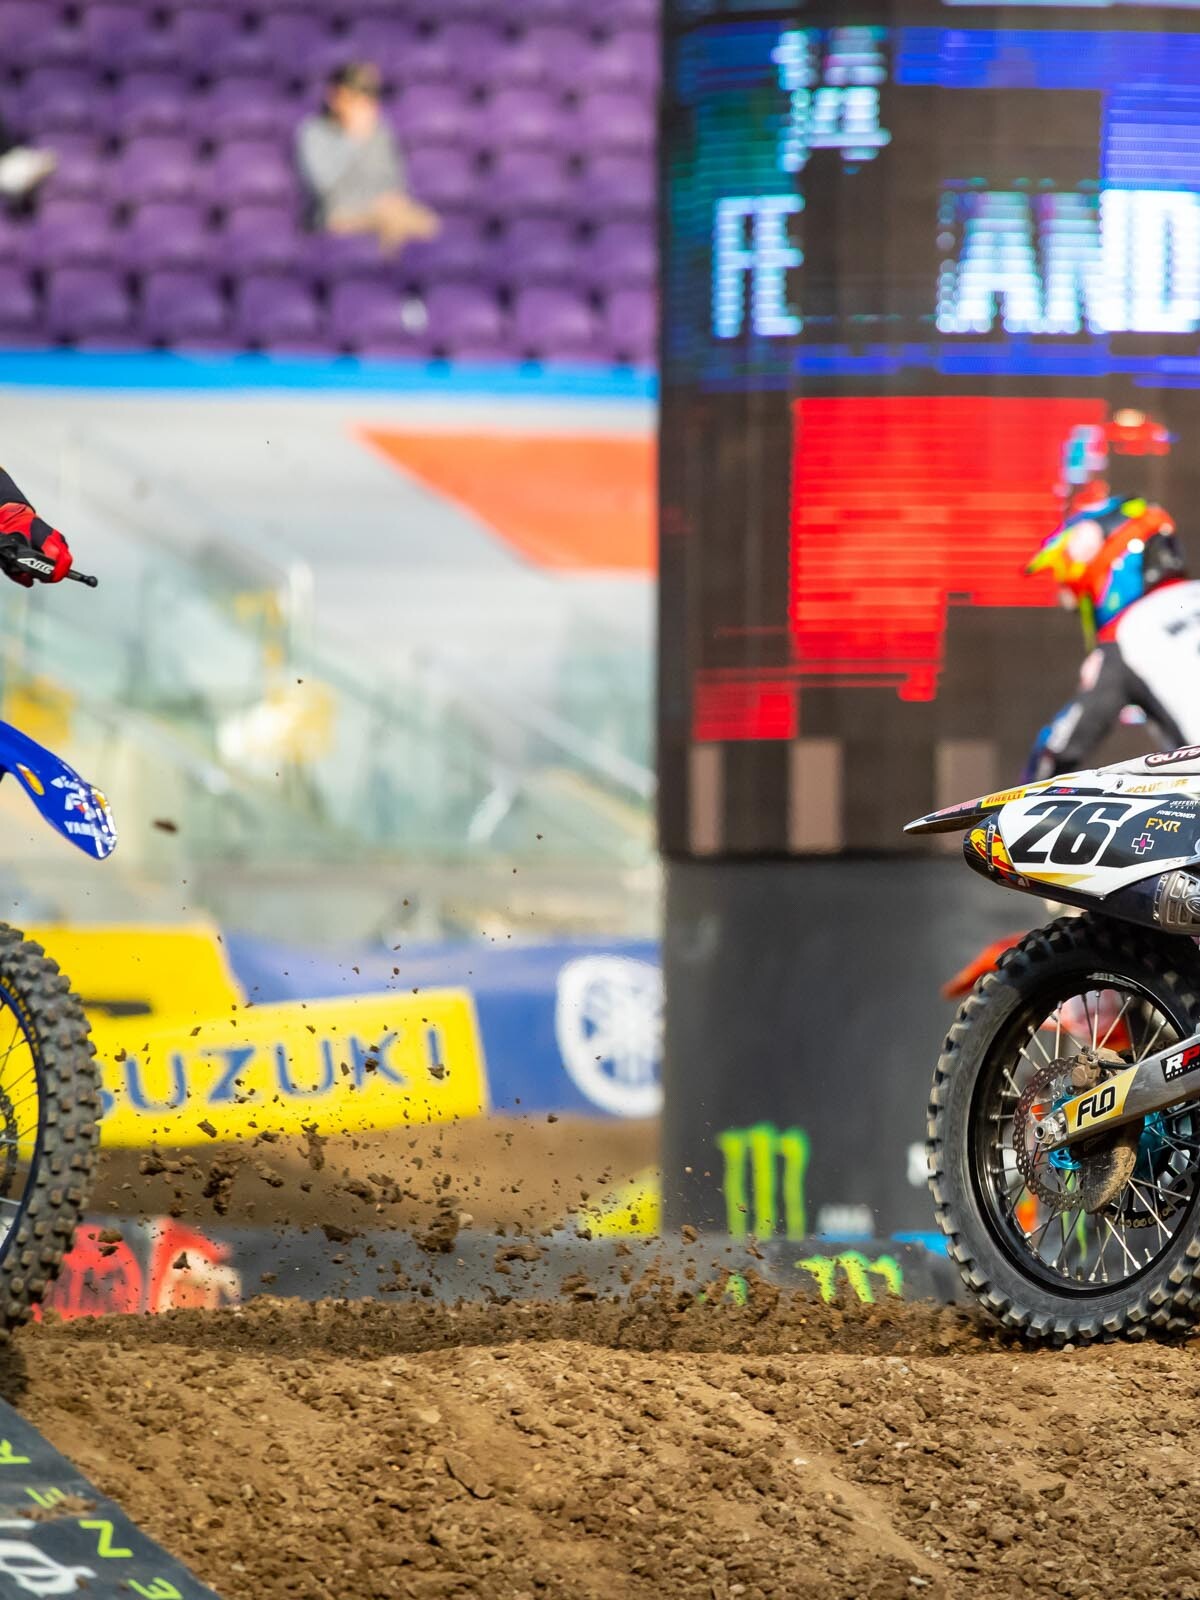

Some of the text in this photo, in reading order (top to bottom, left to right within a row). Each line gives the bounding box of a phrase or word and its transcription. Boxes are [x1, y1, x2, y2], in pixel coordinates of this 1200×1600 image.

[1008, 799, 1133, 866] 26
[1145, 817, 1181, 833] FXR
[1076, 1086, 1116, 1128] FLO
